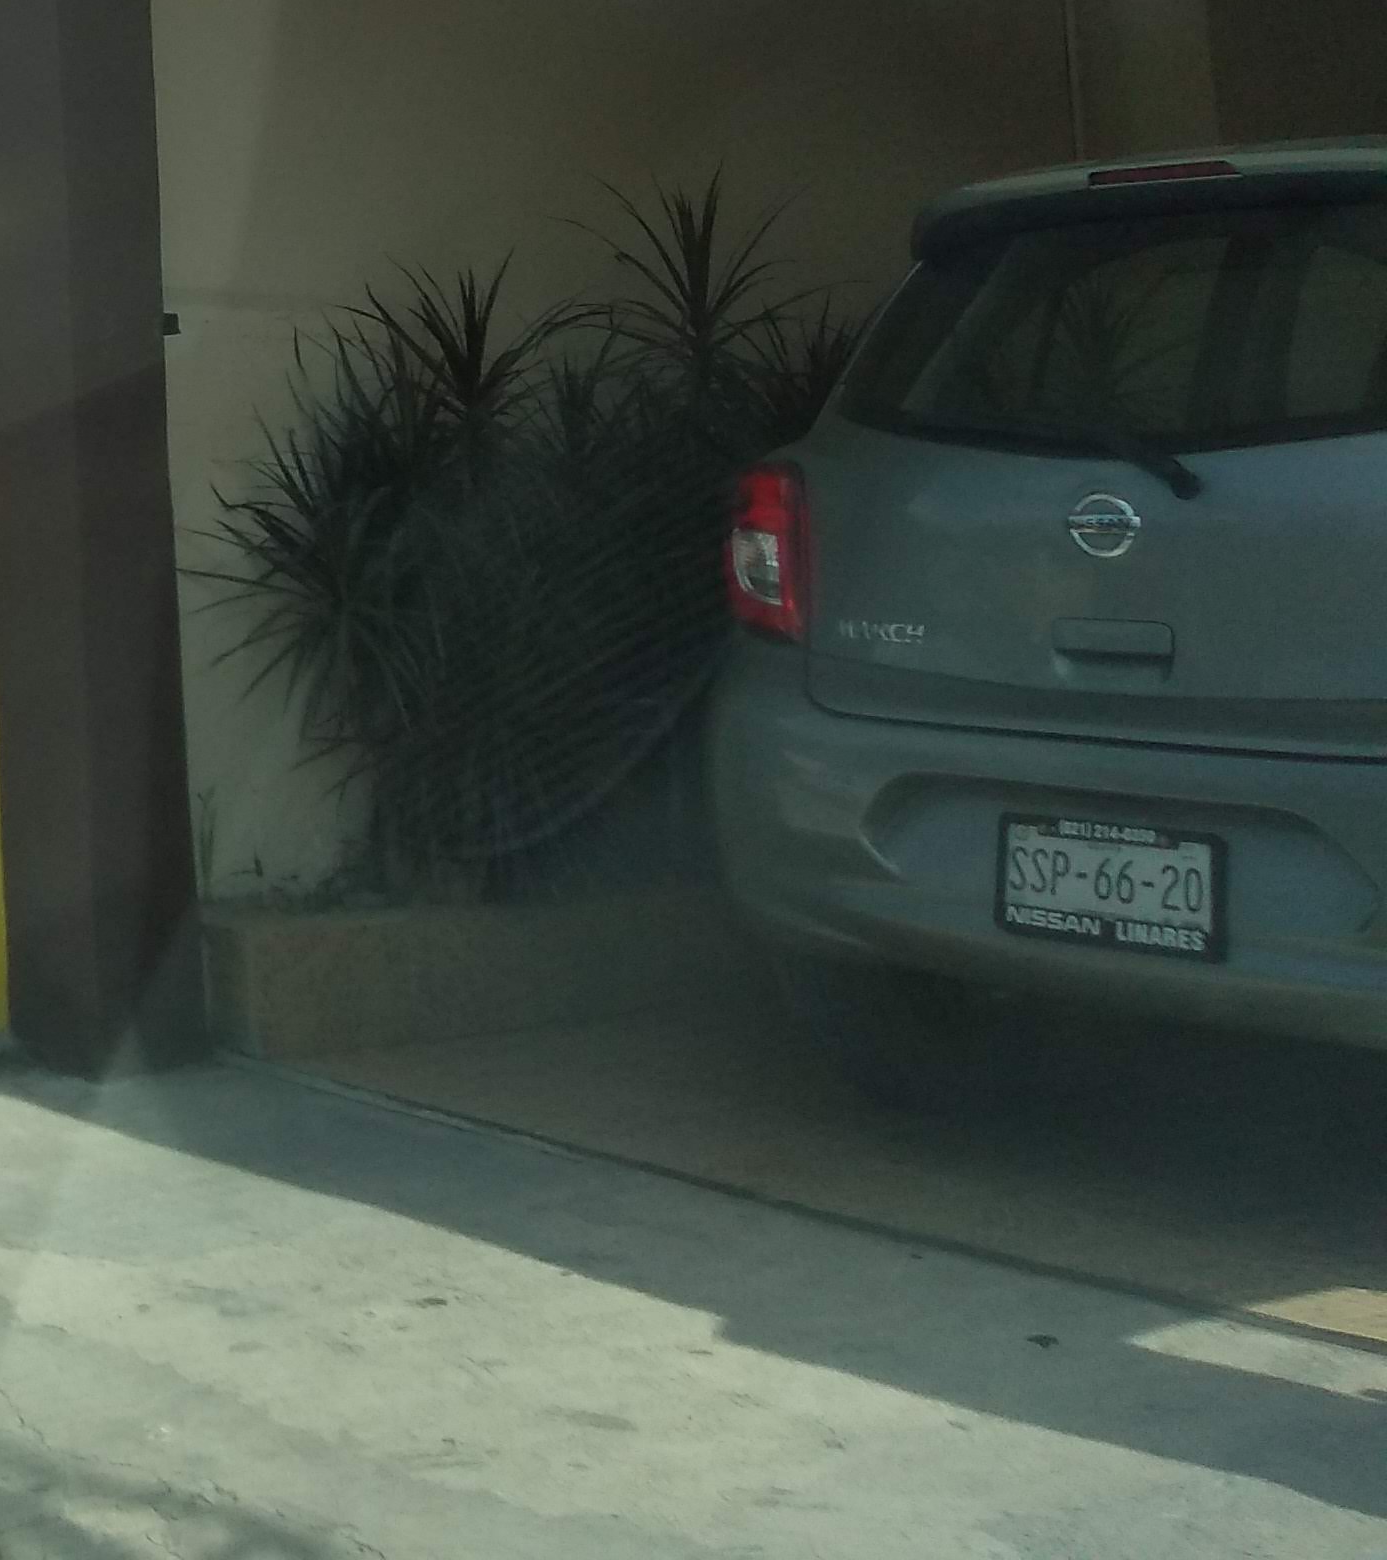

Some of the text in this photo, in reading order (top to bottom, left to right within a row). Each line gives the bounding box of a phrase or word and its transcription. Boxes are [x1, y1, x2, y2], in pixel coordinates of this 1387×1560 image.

[1008, 845, 1204, 912] SSP-66-20
[1006, 905, 1206, 952] NISSAN LINARES
